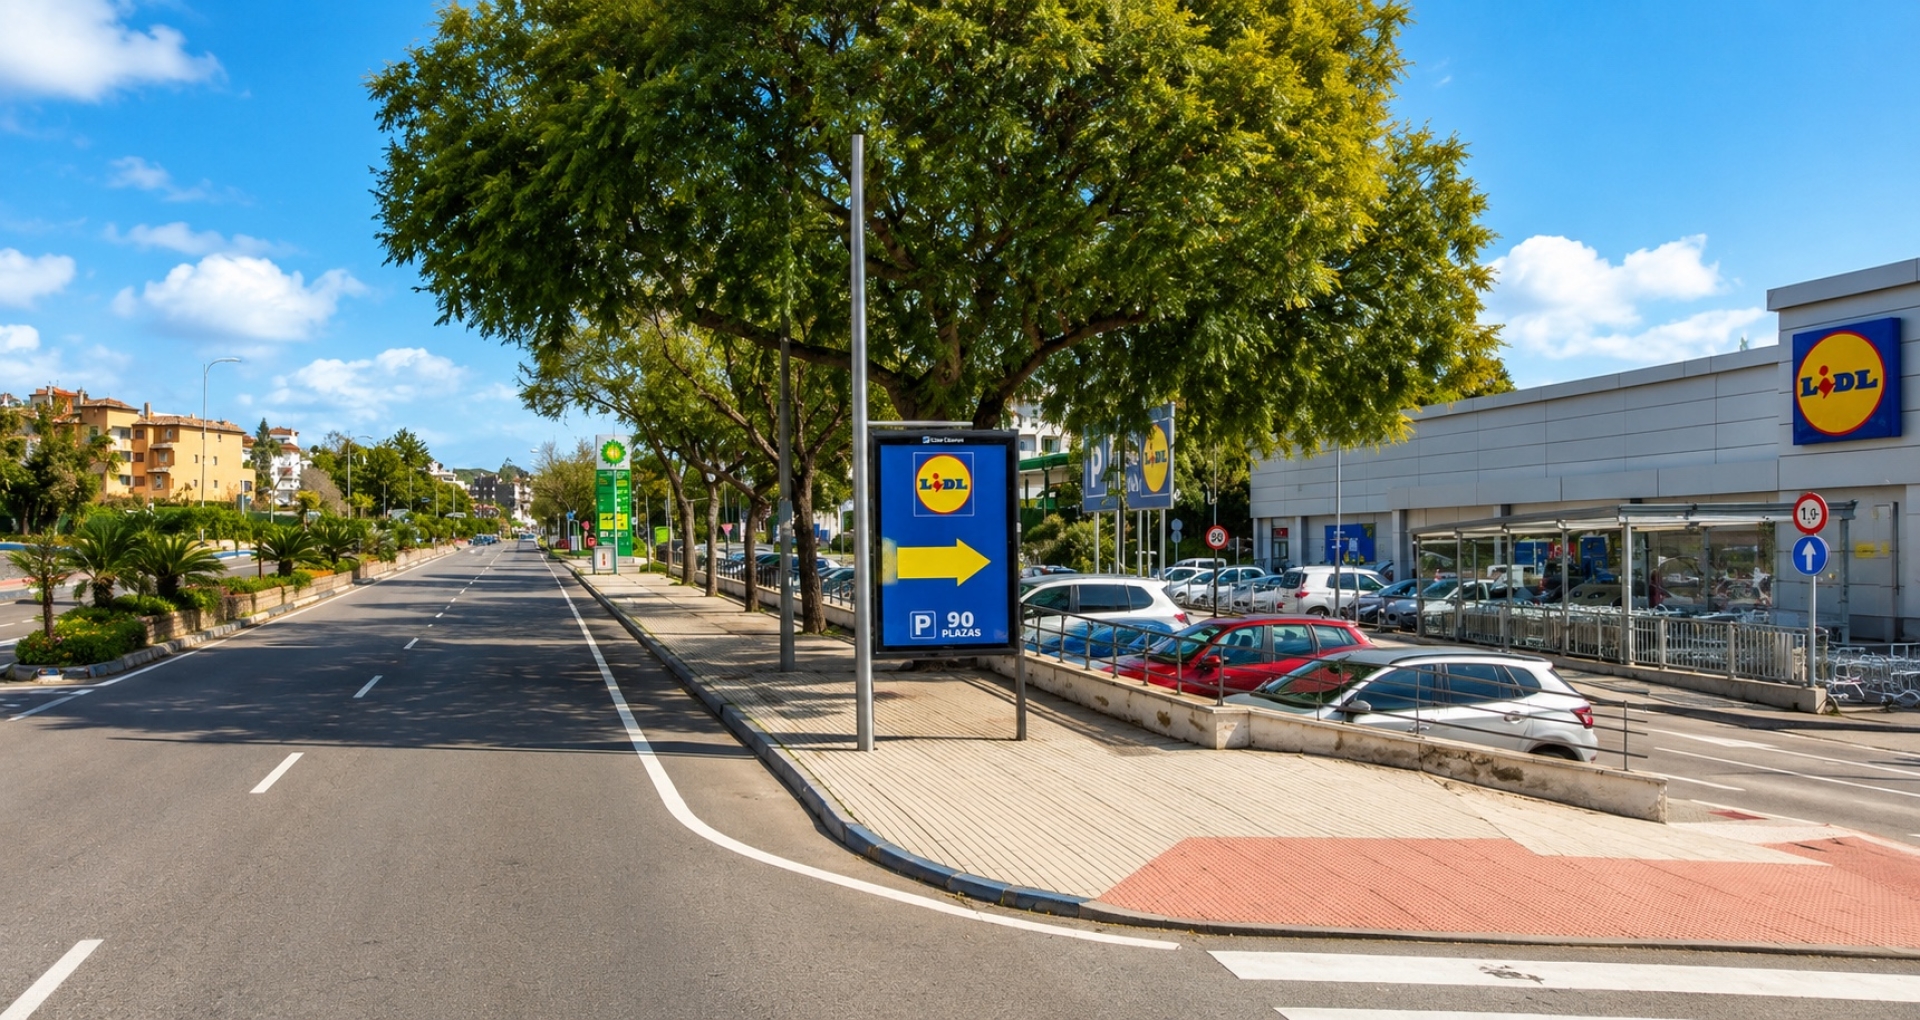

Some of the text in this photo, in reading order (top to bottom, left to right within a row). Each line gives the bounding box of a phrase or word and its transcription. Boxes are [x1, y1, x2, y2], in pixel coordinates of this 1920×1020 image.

[915, 614, 931, 635] P
[947, 611, 974, 628] 90
[941, 628, 982, 638] PLAZAS
